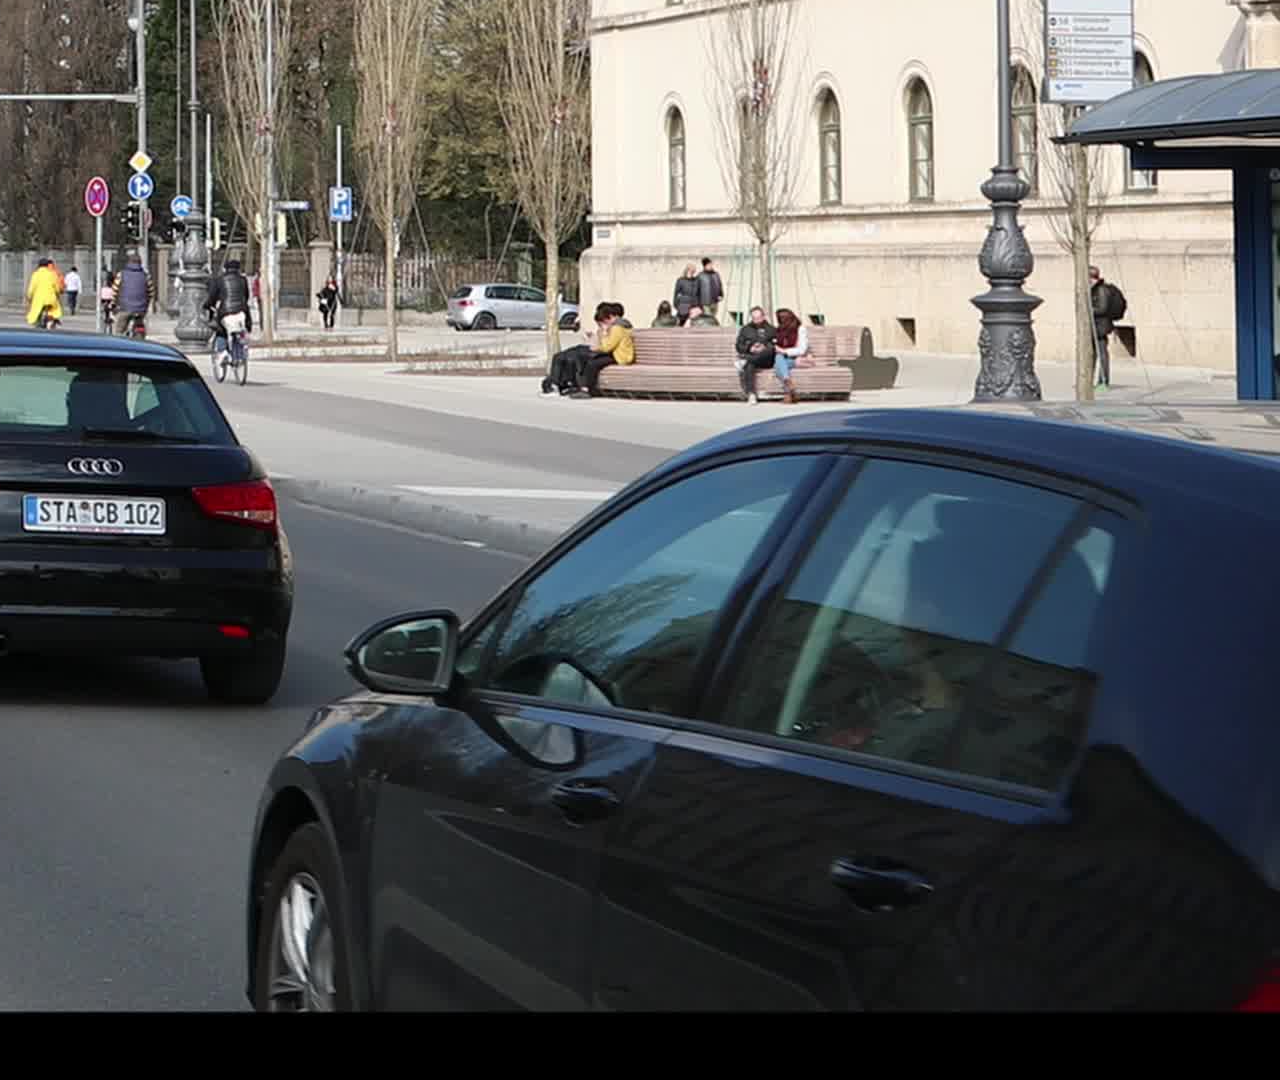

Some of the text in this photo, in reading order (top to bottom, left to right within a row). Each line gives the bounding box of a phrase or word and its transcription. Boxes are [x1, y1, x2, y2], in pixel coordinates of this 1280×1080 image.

[39, 501, 160, 525] STA CB 102
